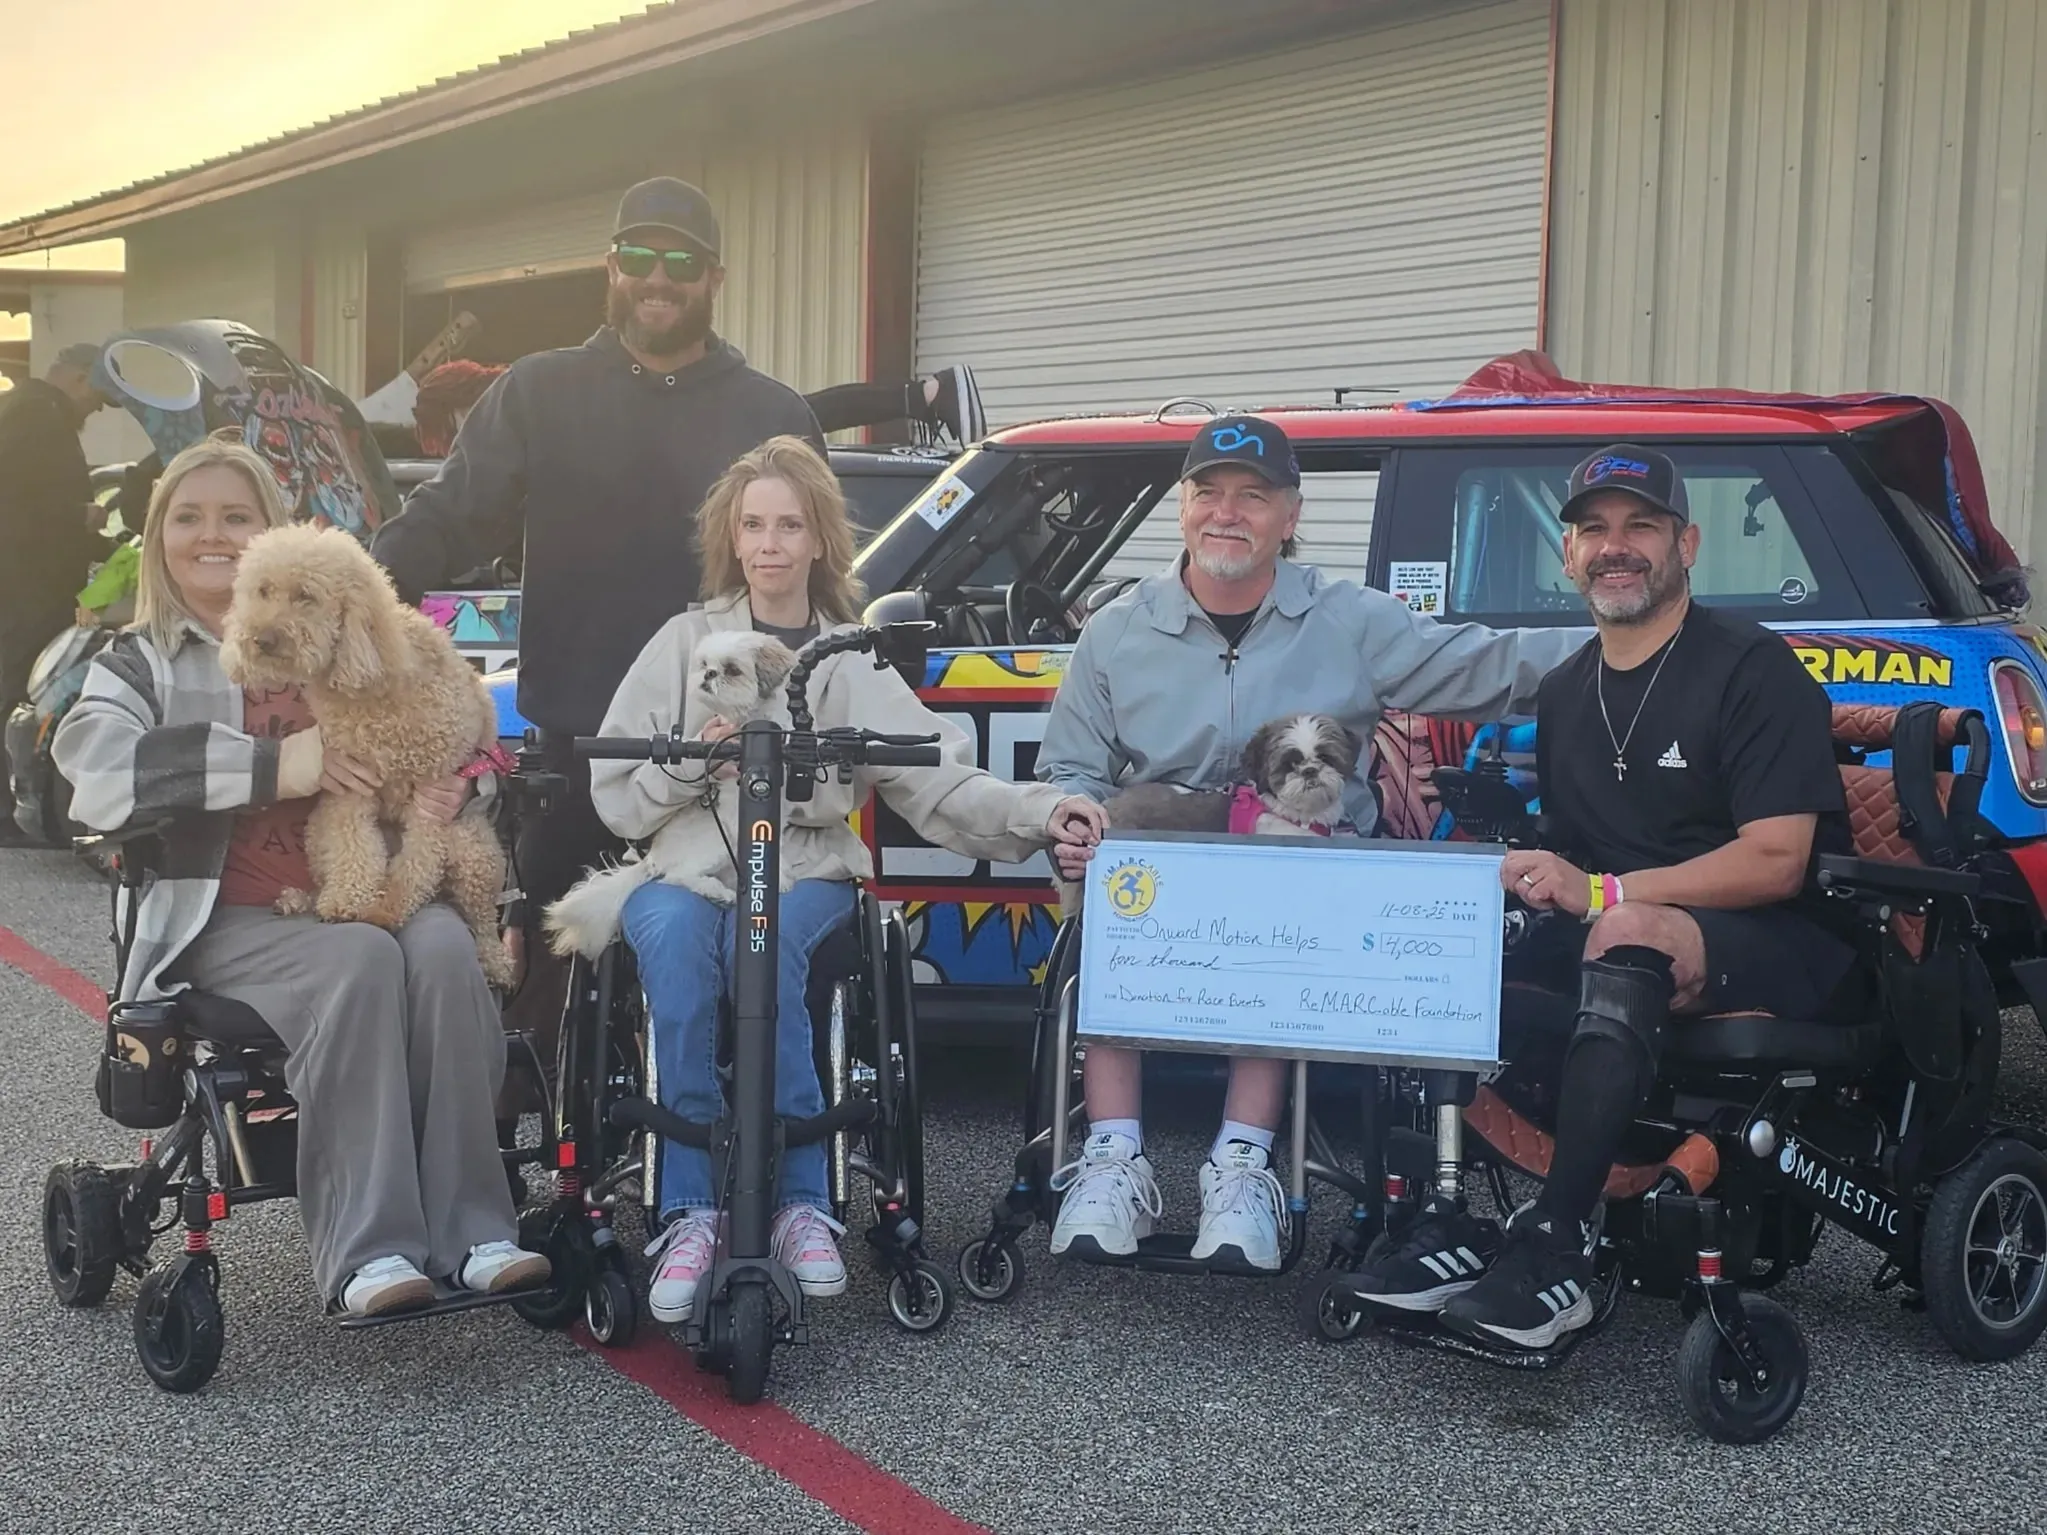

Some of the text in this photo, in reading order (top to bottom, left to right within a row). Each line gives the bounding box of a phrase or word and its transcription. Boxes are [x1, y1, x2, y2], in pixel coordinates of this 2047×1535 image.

[1657, 758, 1688, 768] adidas
[748, 820, 773, 913] Empulse
[1141, 917, 1319, 955] Onward Motion Helps
[1386, 936, 1443, 960] 4,000
[1119, 985, 1174, 1003] Donation
[1415, 996, 1482, 1022] Foundation
[1795, 1153, 1898, 1235] MAJESTIC
